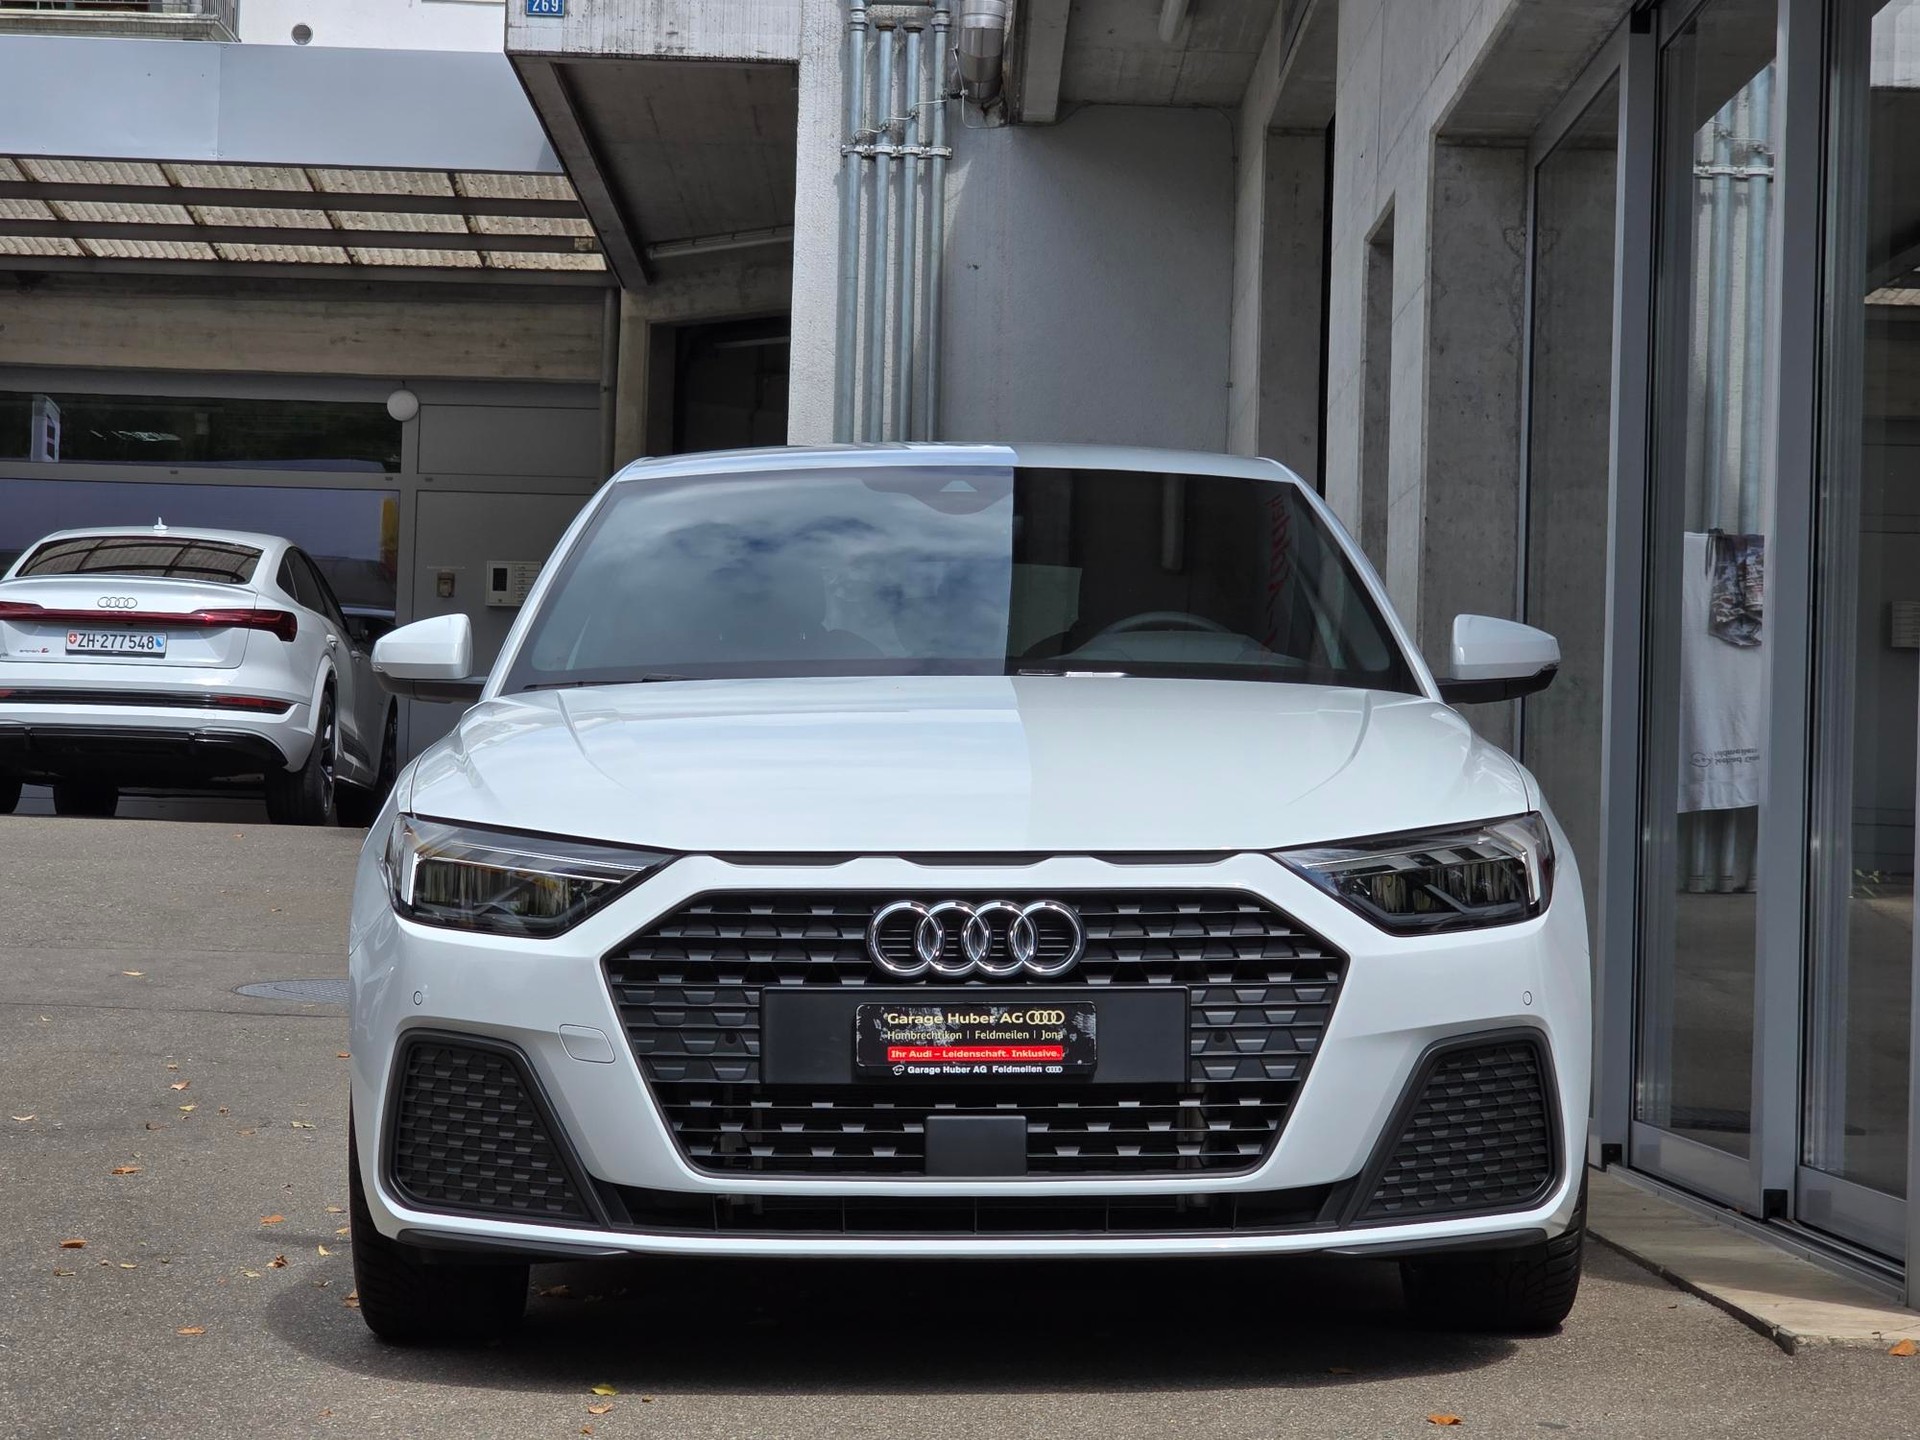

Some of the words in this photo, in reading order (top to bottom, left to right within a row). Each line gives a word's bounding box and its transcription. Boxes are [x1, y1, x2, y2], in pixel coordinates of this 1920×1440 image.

[532, 0, 559, 12] 269
[887, 1013, 944, 1026] Garage
[947, 1013, 996, 1024] Huber
[1000, 1013, 1024, 1024] AG
[887, 1030, 962, 1040] Hombrechtikon
[975, 1030, 1030, 1040] Feldmeilen
[1041, 1030, 1064, 1041] Jona
[891, 1050, 907, 1058] Ihr
[909, 1050, 932, 1058] Audi
[943, 1050, 1010, 1058] Leidenschaft.
[1012, 1050, 1061, 1058] Inklusive.
[907, 1066, 941, 1075] Garage
[943, 1066, 971, 1074] Huber
[973, 1066, 988, 1074] AG
[992, 1065, 1043, 1074] Feldmeilen
